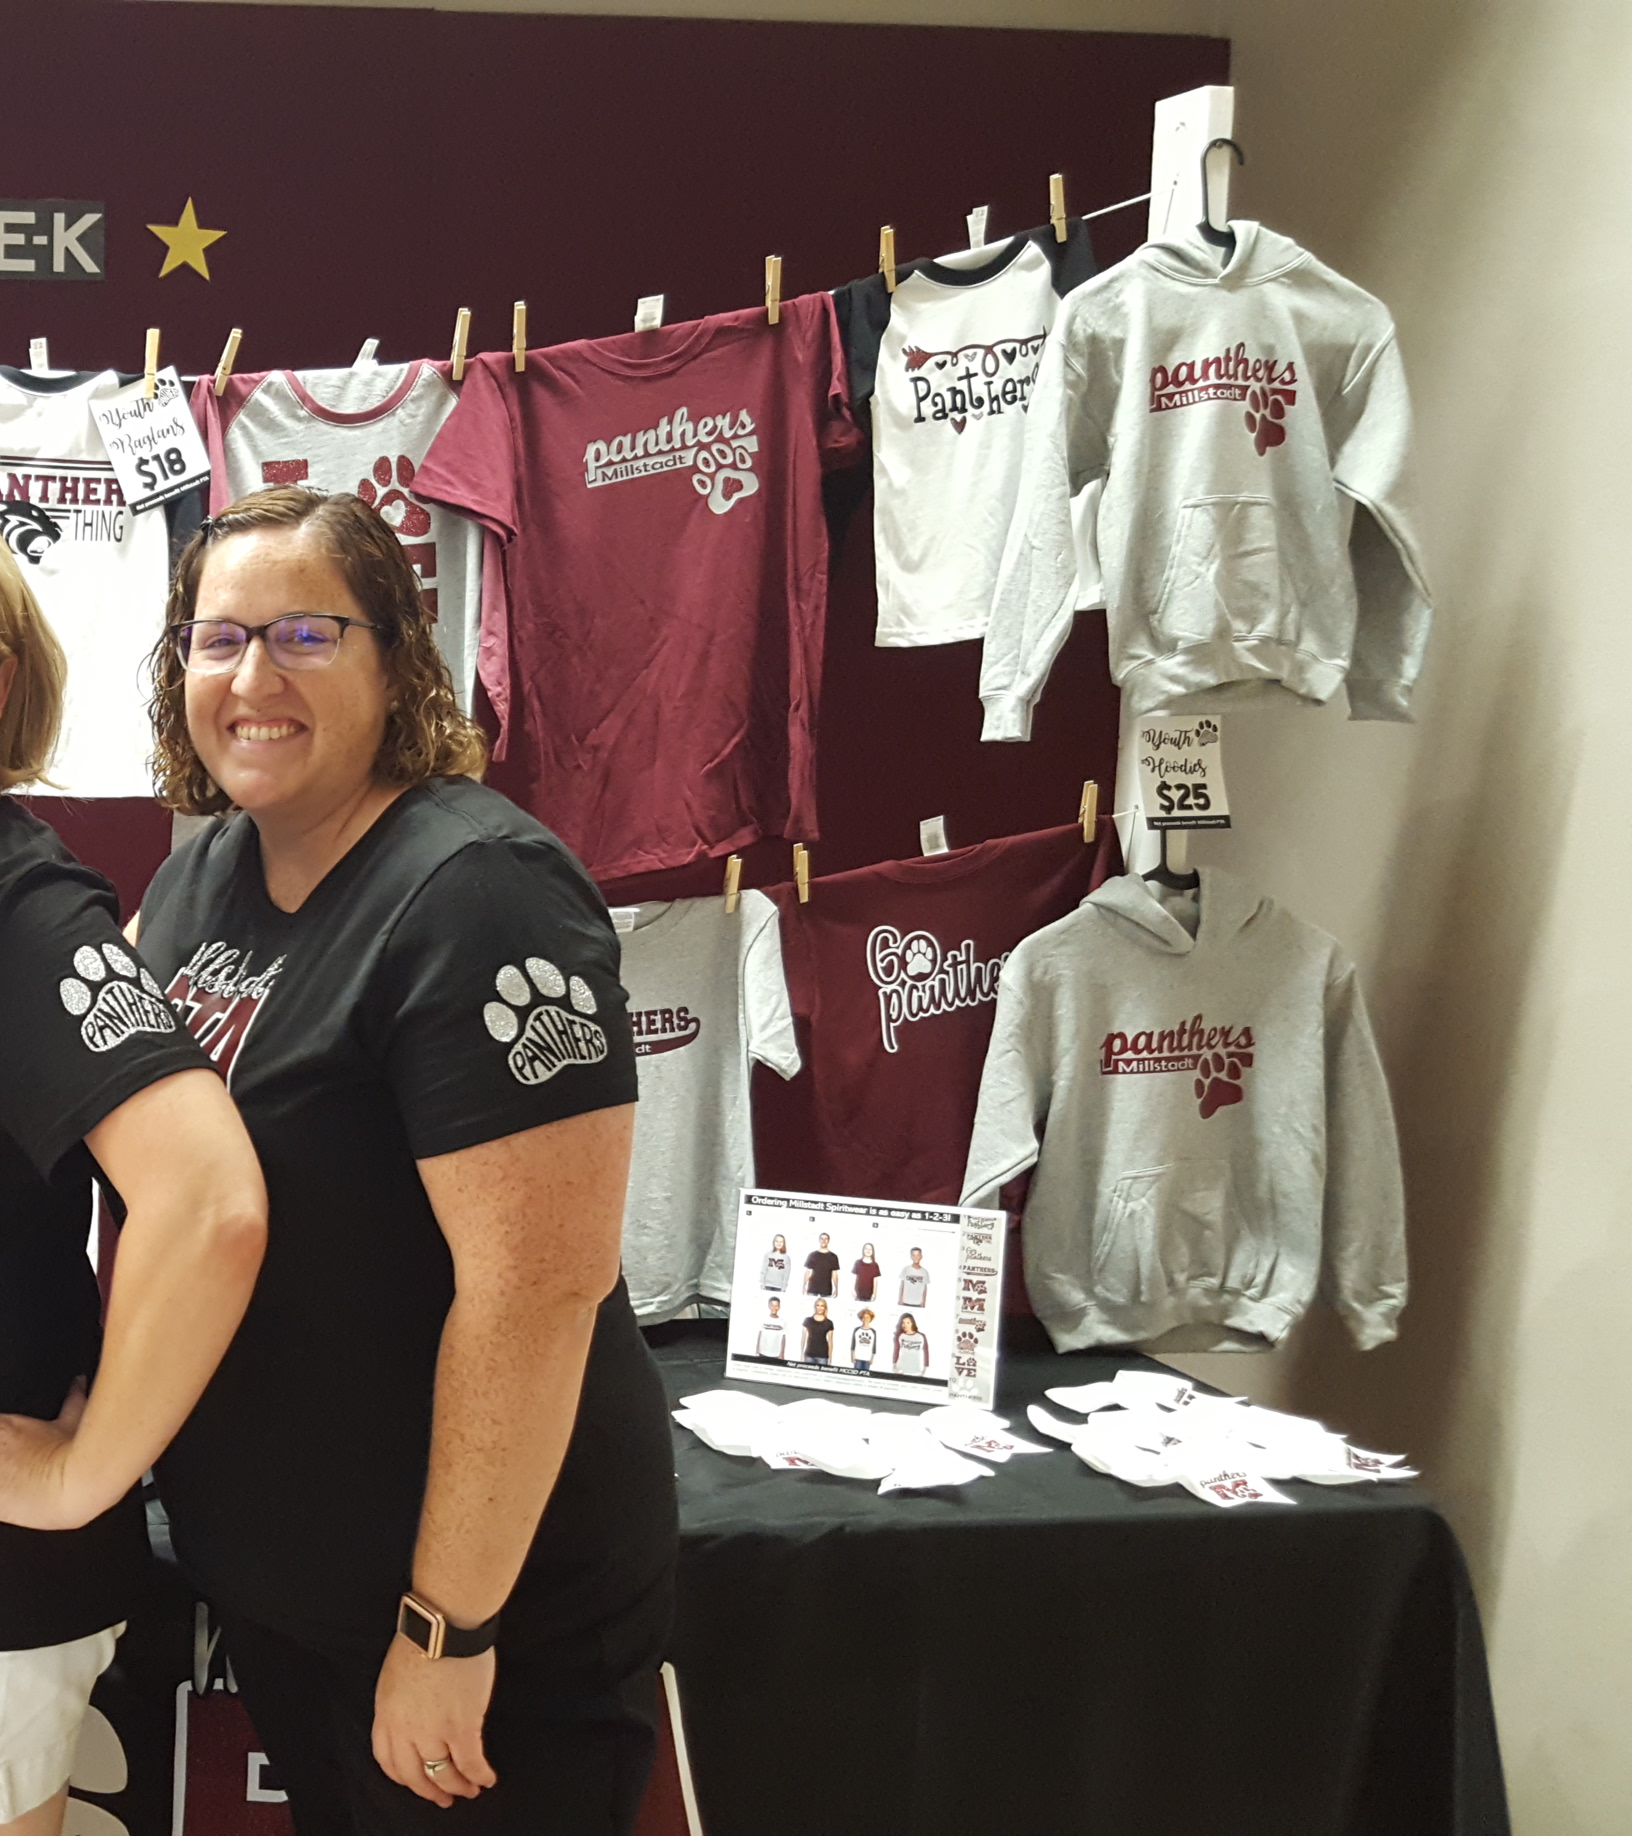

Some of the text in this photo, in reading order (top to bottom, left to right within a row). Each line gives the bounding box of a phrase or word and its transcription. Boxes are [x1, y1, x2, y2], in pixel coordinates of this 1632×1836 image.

[1148, 341, 1298, 400] panthers
[99, 398, 155, 429] Youth
[1160, 386, 1243, 410] Millstadt
[109, 416, 186, 456] Raglans
[583, 404, 757, 485] panthers
[134, 446, 187, 492] $18
[600, 452, 688, 484] Millstadt
[73, 508, 124, 543] THING
[1141, 728, 1194, 751] Youth
[1141, 756, 1208, 778] Hoodies
[1155, 780, 1212, 815] $25
[84, 984, 174, 1050] PANTHERS
[512, 1009, 606, 1082] PANTHERS
[1102, 1012, 1256, 1071] panthers
[1117, 1056, 1194, 1075] Millstadt
[751, 1195, 788, 1208] Ordering
[789, 1198, 825, 1211] Millstadt
[825, 1202, 868, 1215] Spiritwear
[869, 1206, 878, 1215] is
[890, 1210, 910, 1220] easy
[910, 1212, 922, 1220] as
[924, 1212, 952, 1222] 1-2-3!
